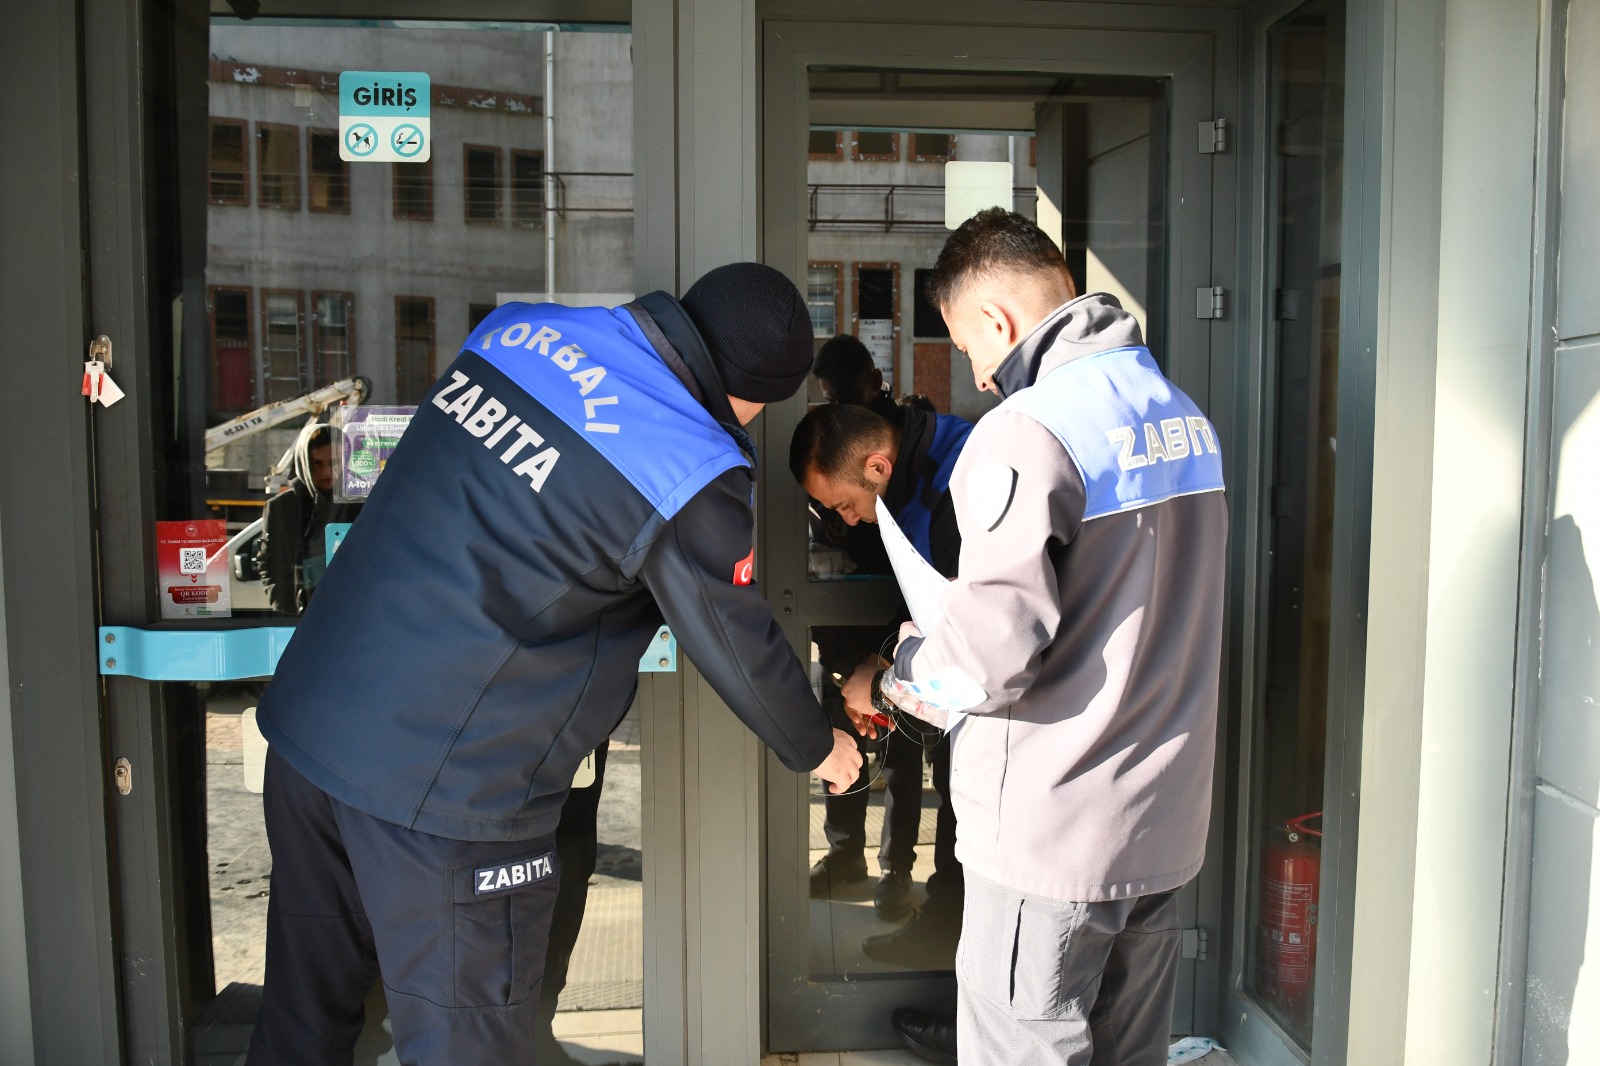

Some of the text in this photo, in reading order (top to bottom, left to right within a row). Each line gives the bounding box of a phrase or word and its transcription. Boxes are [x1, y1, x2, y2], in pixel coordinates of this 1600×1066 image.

[353, 82, 417, 111] GİRİŞ
[479, 322, 621, 434] TORBALI
[431, 369, 561, 494] ZABITA
[478, 855, 553, 891] ZABITA
